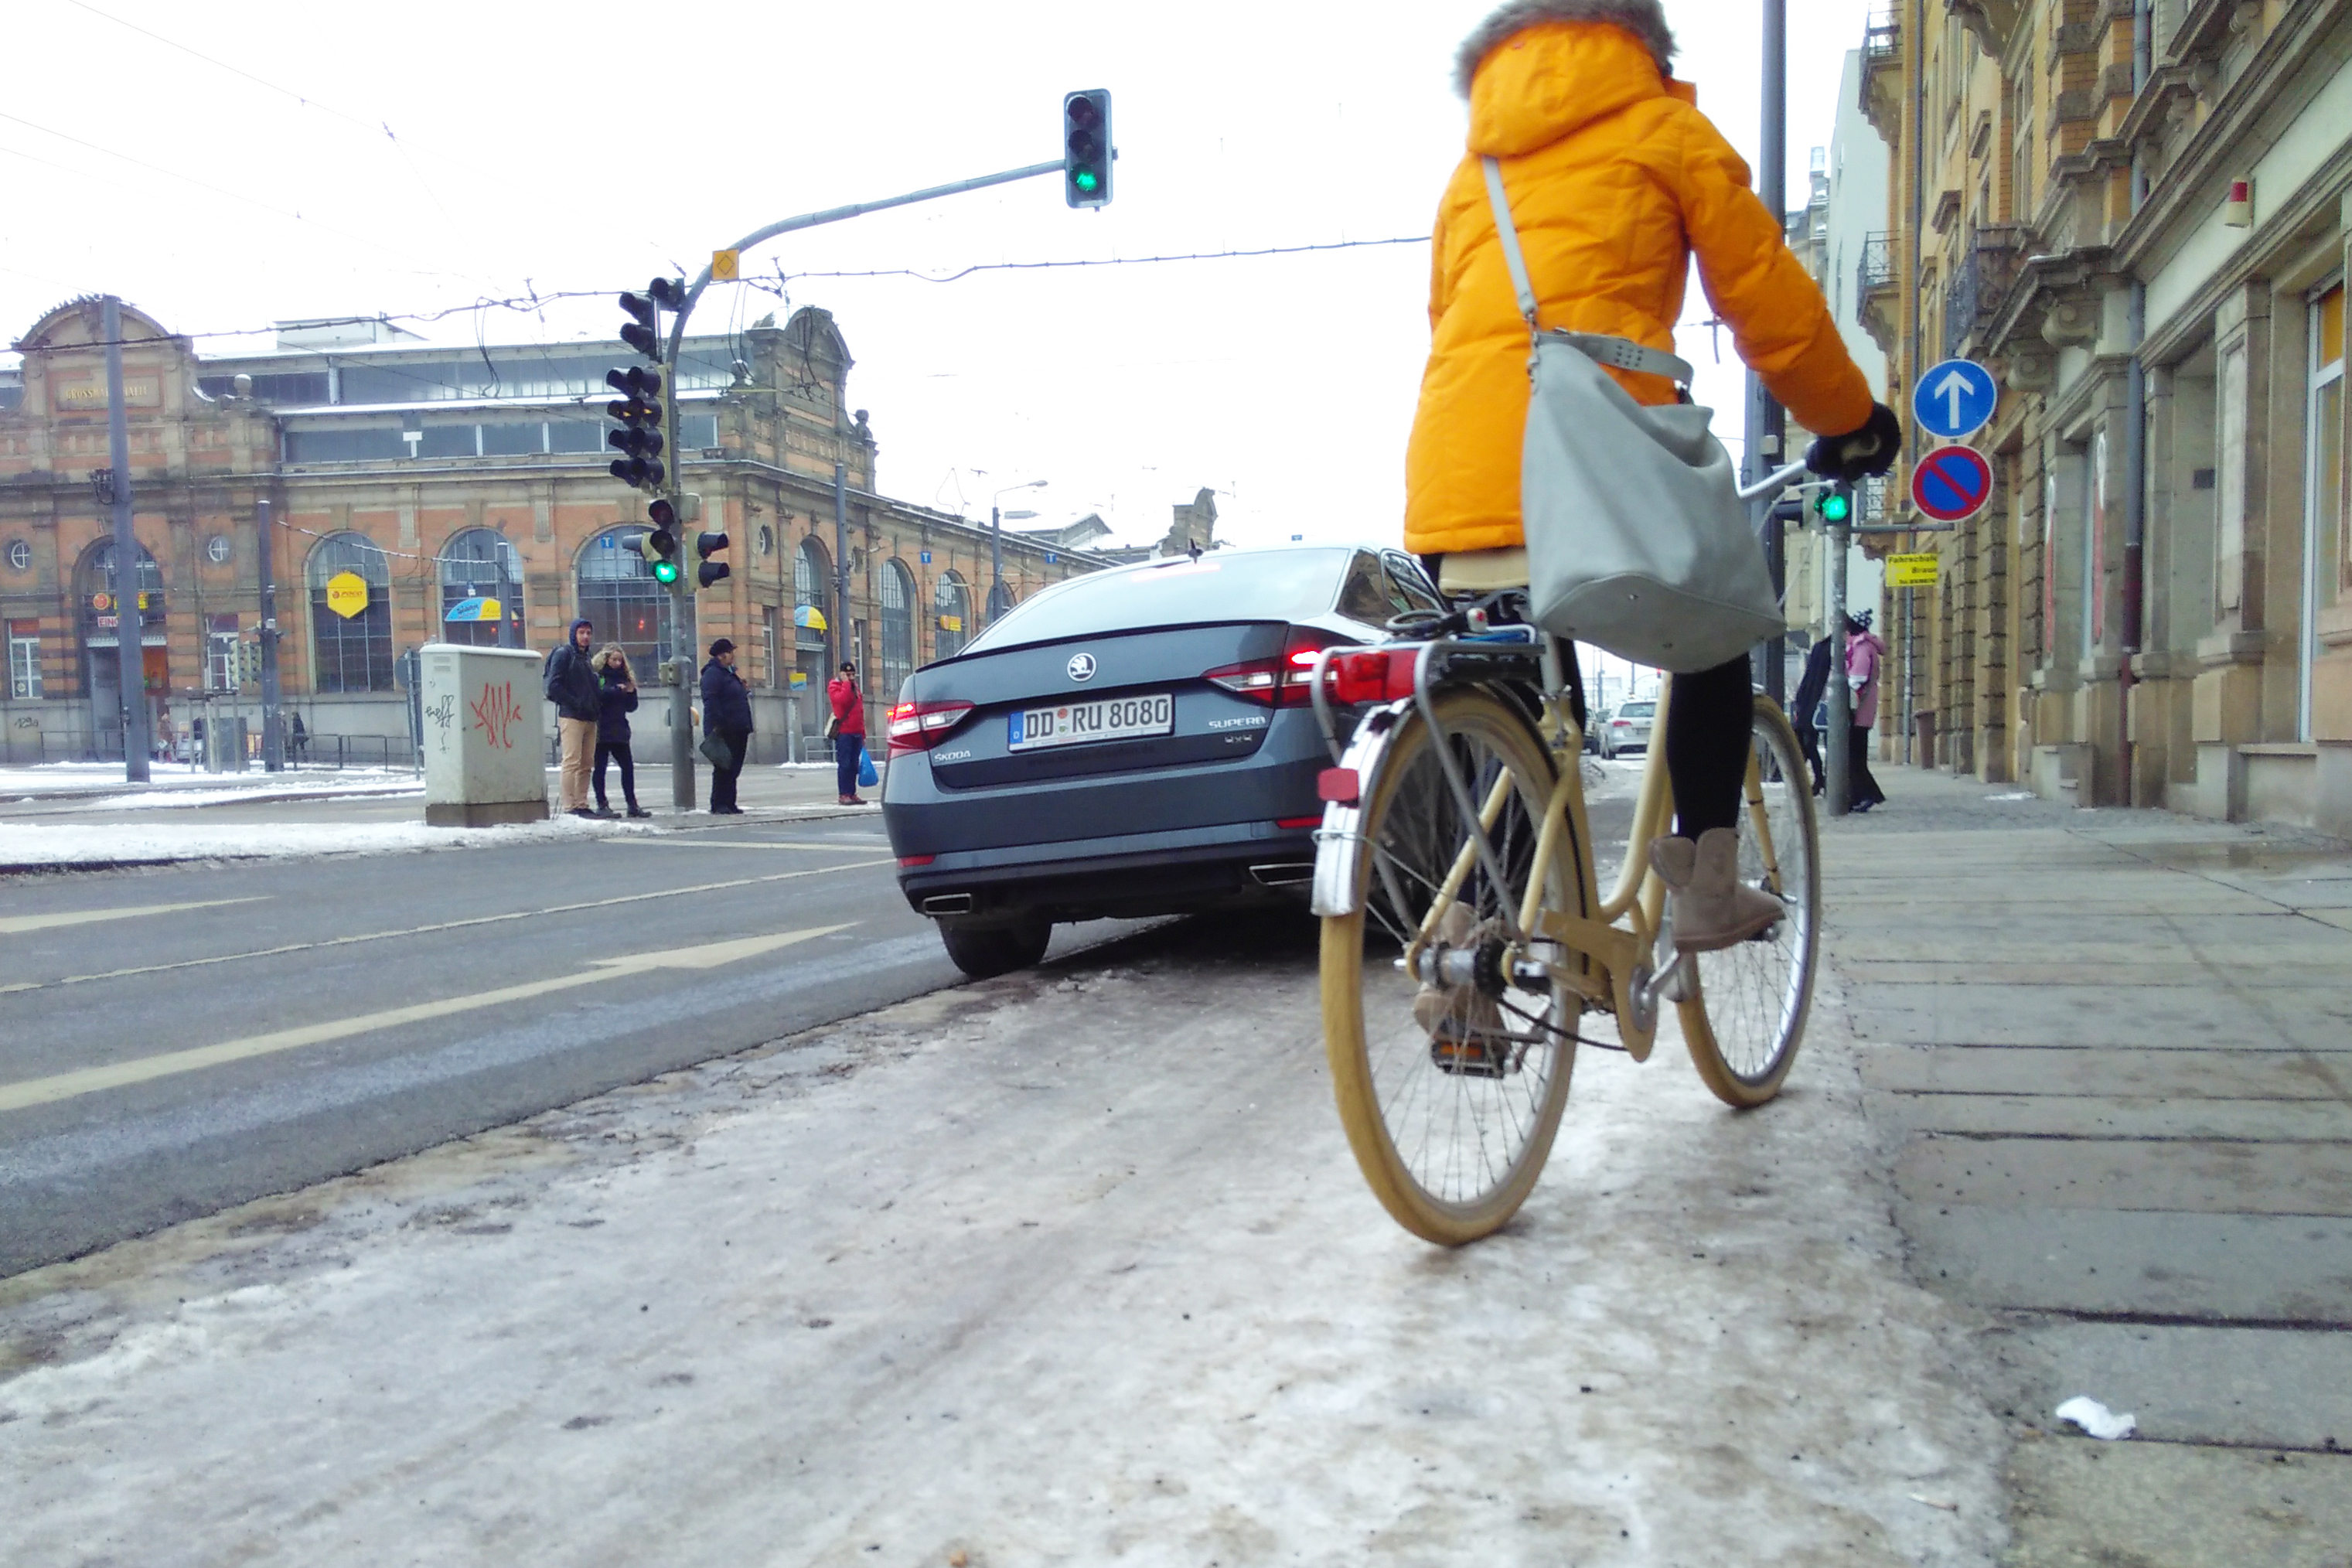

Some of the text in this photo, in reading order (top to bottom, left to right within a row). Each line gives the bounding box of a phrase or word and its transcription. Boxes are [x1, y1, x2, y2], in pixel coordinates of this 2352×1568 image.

[922, 553, 929, 562] T
[1025, 711, 1054, 739] DD
[1072, 704, 1103, 733] RU
[1109, 698, 1169, 729] 8080
[1208, 716, 1266, 728] SUPERB
[1013, 731, 1020, 739] D
